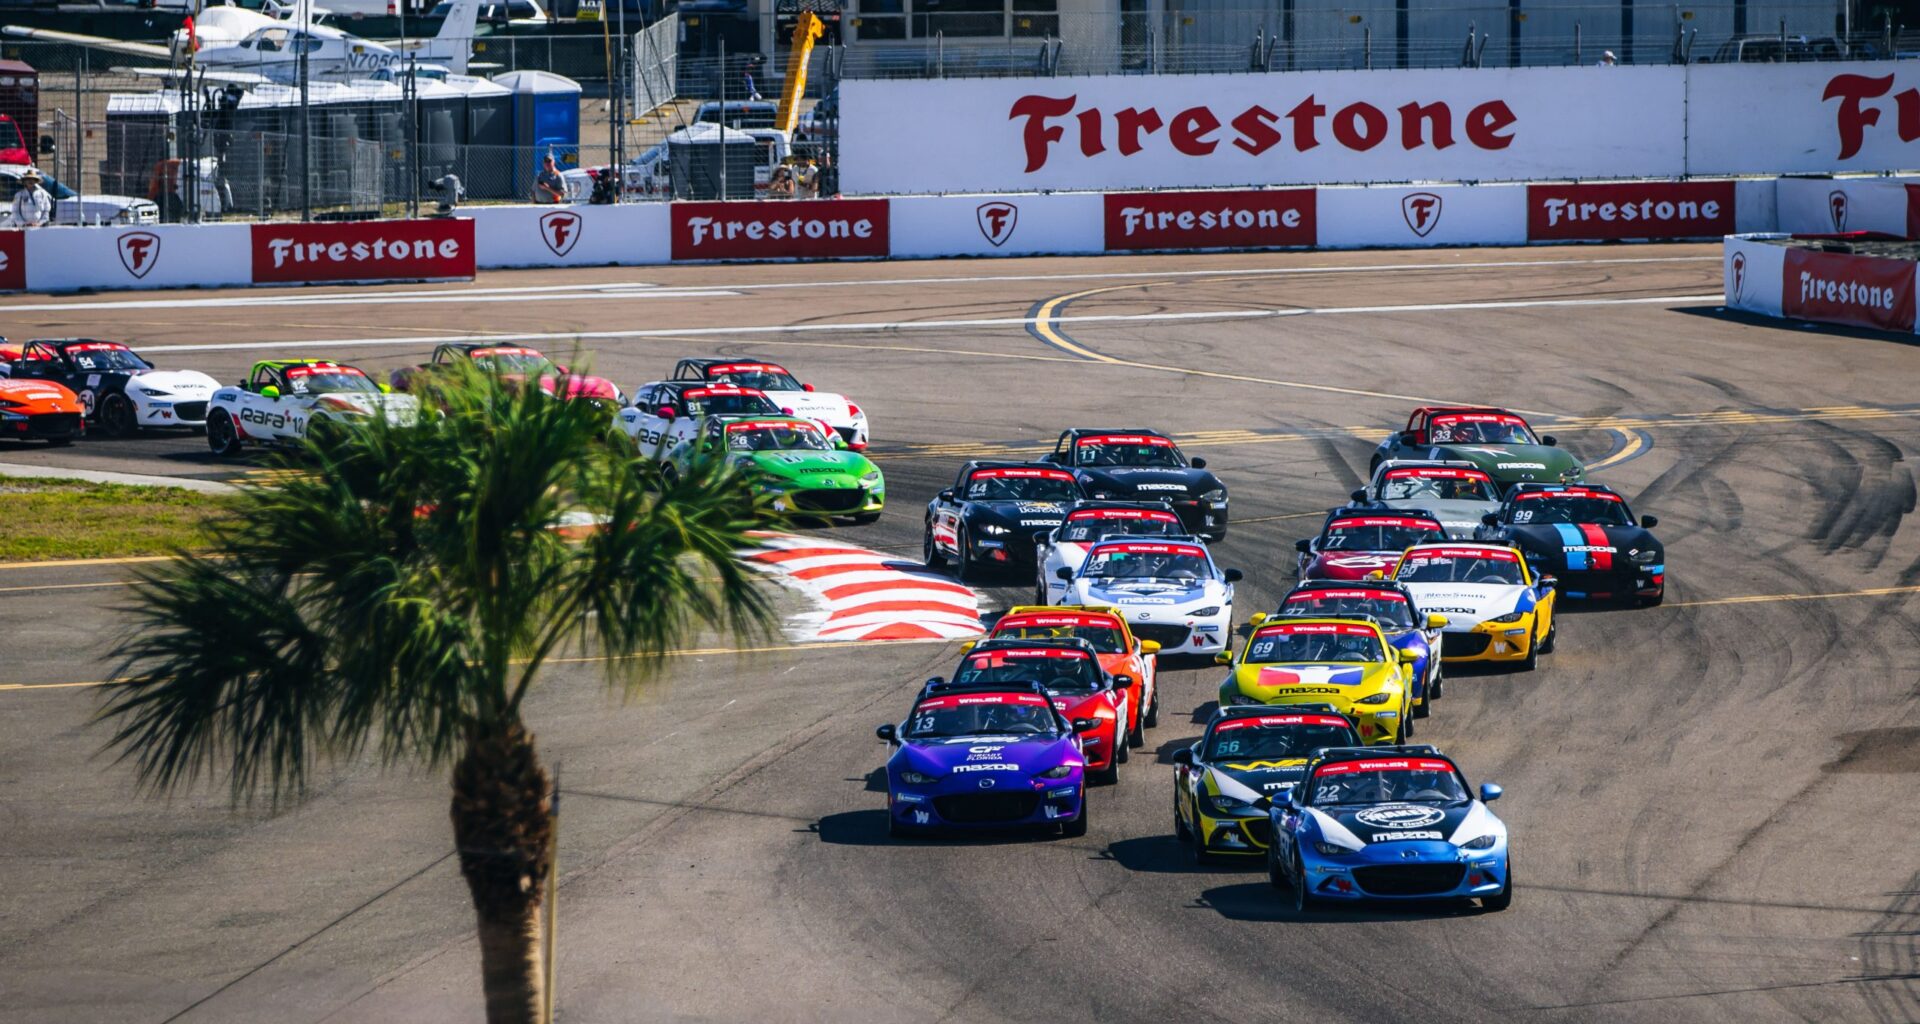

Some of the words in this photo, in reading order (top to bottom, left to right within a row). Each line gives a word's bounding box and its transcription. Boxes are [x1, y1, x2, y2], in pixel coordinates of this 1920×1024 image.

[1009, 93, 1517, 173] Firestone
[1543, 197, 1721, 227] Firestone
[1120, 206, 1302, 236] Firestone
[687, 215, 874, 246] Firestone
[268, 236, 459, 269] Firestone
[1800, 271, 1895, 310] Firestone
[687, 401, 701, 411] 81
[292, 416, 304, 434] 12
[730, 435, 748, 445] 26
[1435, 430, 1452, 440] 33
[1080, 450, 1096, 460] 11
[969, 483, 987, 493] 44
[1137, 483, 1188, 491] mazda
[1514, 510, 1534, 521] 99
[1071, 527, 1088, 539] 19
[1327, 536, 1347, 547] 77
[1088, 560, 1104, 571] 23
[1118, 597, 1176, 605] mazda
[1252, 641, 1274, 654] 69
[961, 670, 982, 682] 57
[1279, 687, 1340, 695] mazda
[958, 696, 1003, 704] WHELEN
[915, 717, 935, 729] 13
[1217, 740, 1240, 754] 56
[953, 763, 1019, 773] mazda
[1359, 761, 1409, 769] WHELEN
[1317, 785, 1340, 800] 22
[1372, 831, 1443, 842] mazda
